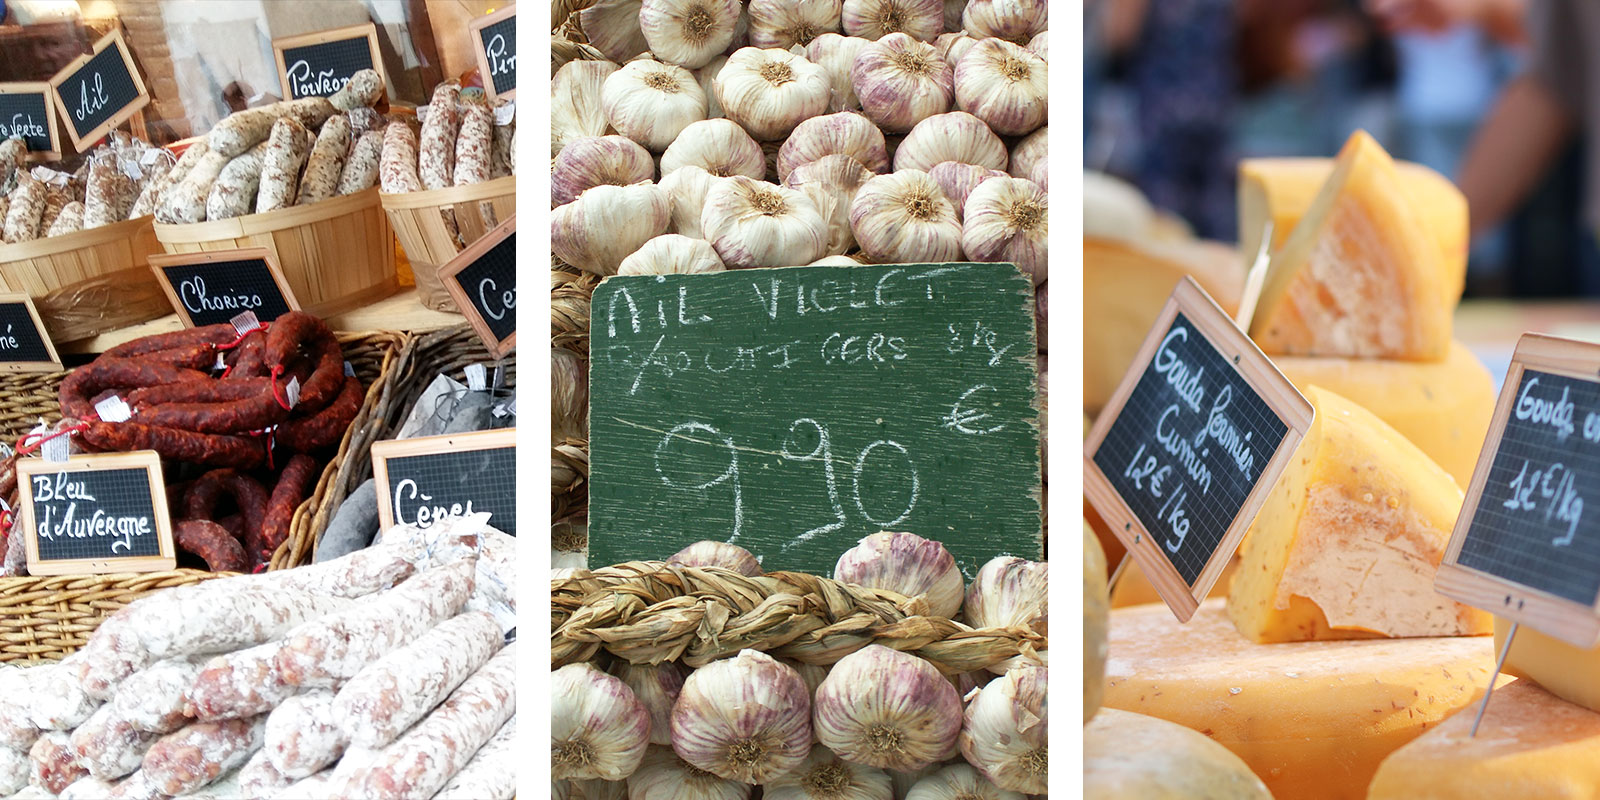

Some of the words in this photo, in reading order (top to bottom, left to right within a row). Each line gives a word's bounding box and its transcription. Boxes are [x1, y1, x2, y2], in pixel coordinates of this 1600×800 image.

[76, 72, 109, 121] Ail
[181, 276, 262, 313] Chorizo
[608, 275, 713, 338] AIL
[821, 332, 907, 365] GERS
[1154, 326, 1205, 414] Gouda
[1515, 377, 1575, 434] Gouda
[1156, 404, 1212, 495] Cumin
[33, 470, 96, 502] Bleu
[38, 502, 151, 554] d'Auvergne
